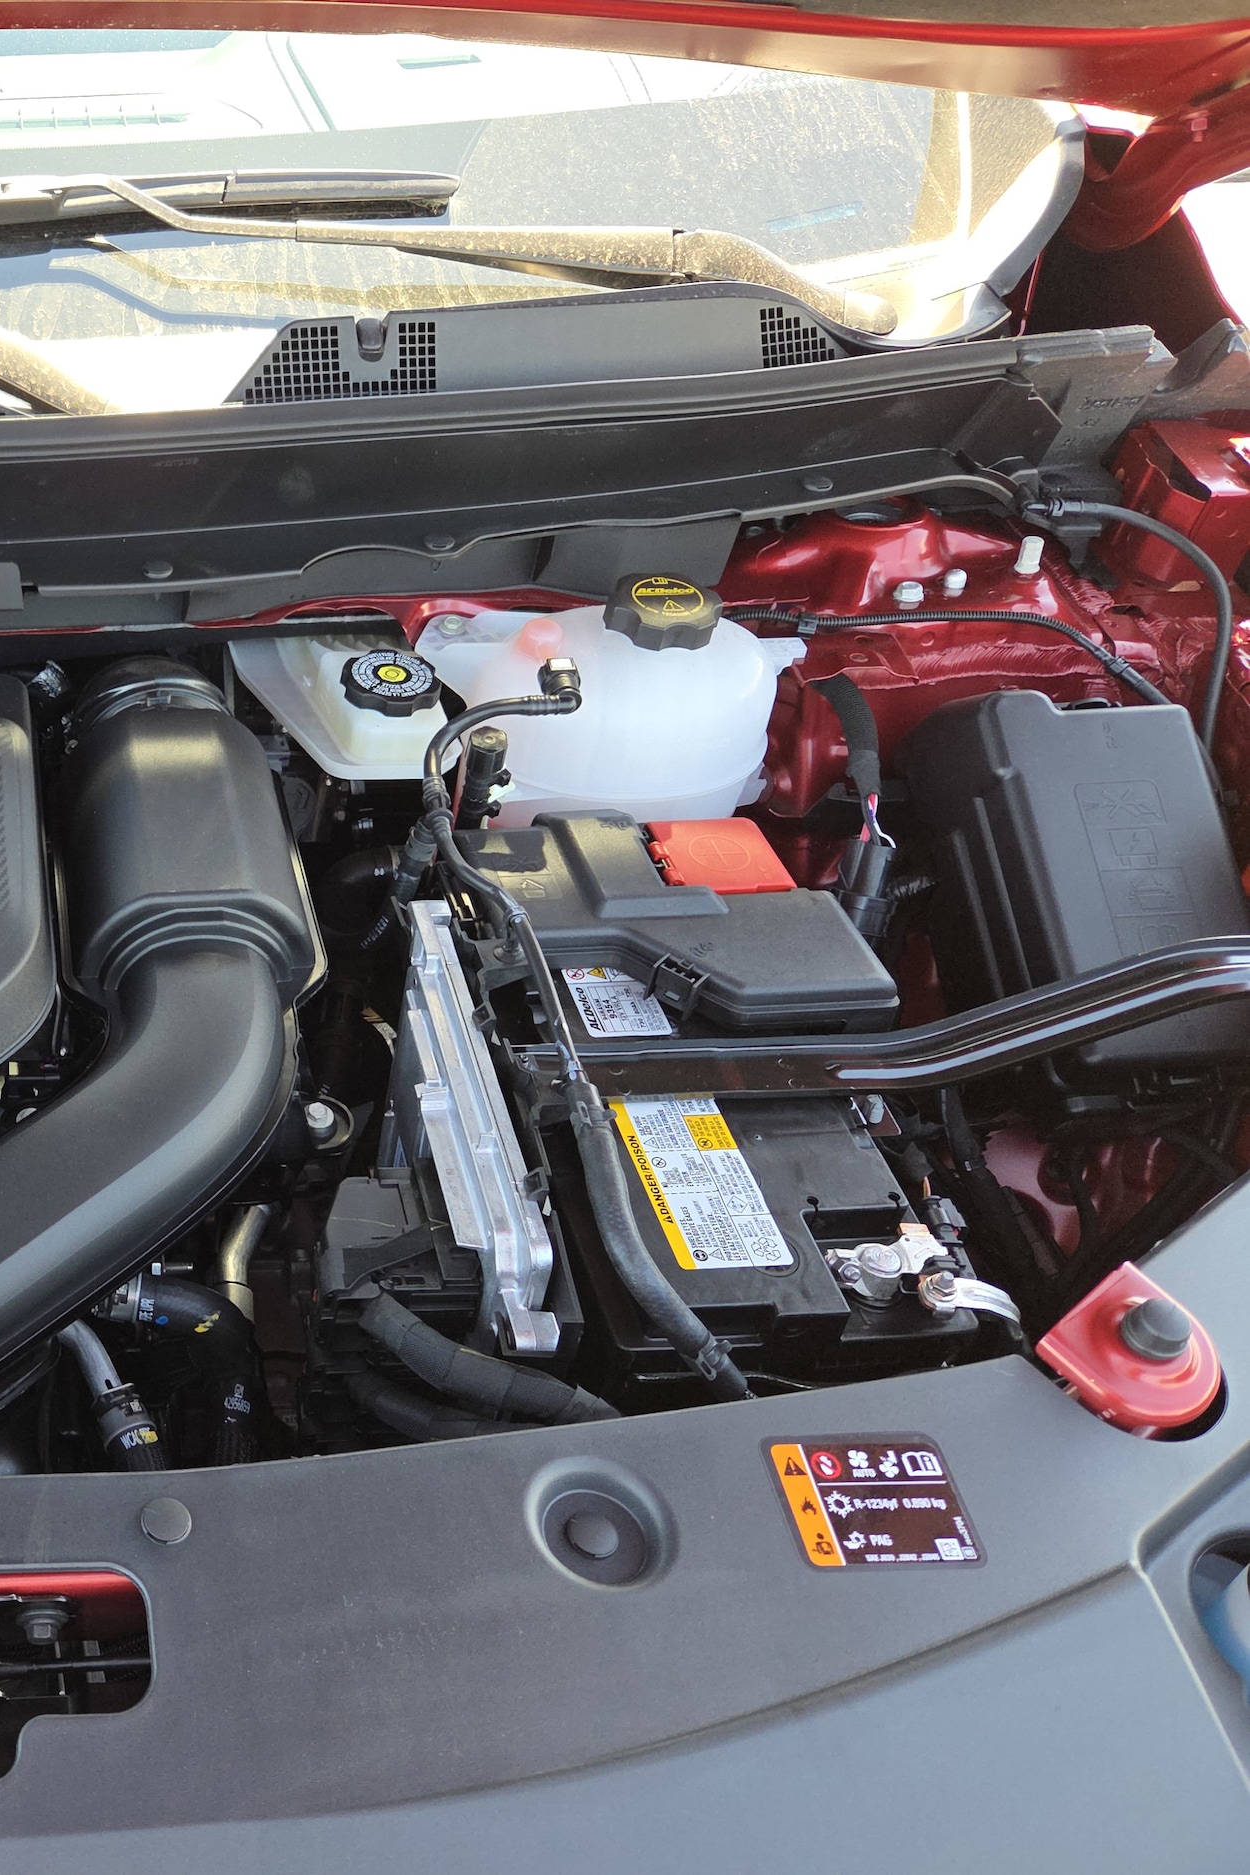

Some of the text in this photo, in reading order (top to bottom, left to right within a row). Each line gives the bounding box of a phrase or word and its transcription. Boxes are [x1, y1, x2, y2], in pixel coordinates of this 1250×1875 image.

[575, 987, 602, 1030] ACDelco
[600, 999, 618, 1018] 9354
[626, 1135, 669, 1214] DANGER/POISON
[680, 1206, 705, 1247] EXPLOSIVE GASES
[852, 1468, 876, 1478] AUTO
[853, 1497, 899, 1512] R-1234yf
[931, 1498, 947, 1511] kg
[869, 1534, 893, 1547] PAG
